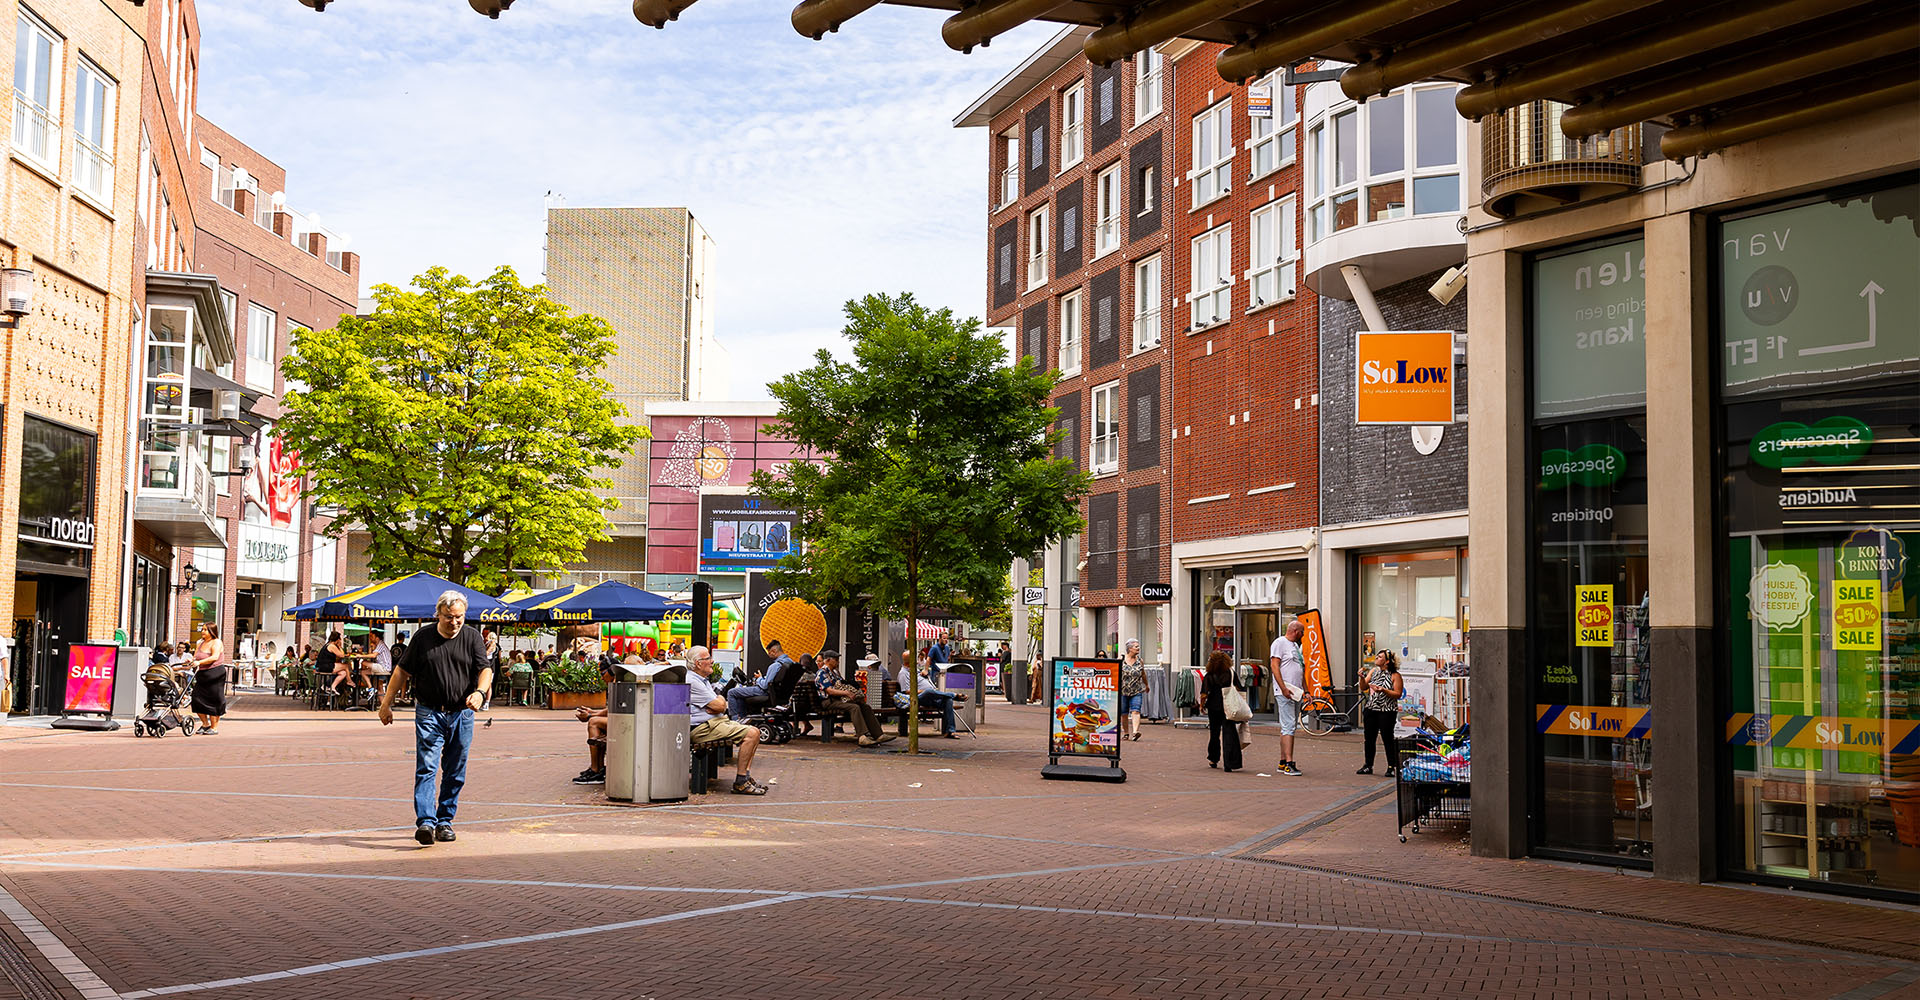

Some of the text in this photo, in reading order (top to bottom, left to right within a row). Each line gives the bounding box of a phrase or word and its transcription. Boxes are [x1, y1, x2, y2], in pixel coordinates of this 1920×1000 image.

[51, 516, 94, 543] norah
[1857, 545, 1885, 558] KOM
[1849, 559, 1896, 572] BINNEN
[1143, 587, 1171, 596] ONLY
[1224, 576, 1283, 606] ONLY
[1763, 581, 1798, 590] HUISJE,
[1581, 590, 1608, 602] SALE
[1763, 591, 1797, 600] HOBBY,
[1839, 586, 1874, 600] SALE
[353, 604, 399, 618] Duvel
[1761, 601, 1800, 610] FEESTJE!
[552, 608, 593, 620] Duvel
[1579, 608, 1610, 624] -50%
[1836, 606, 1876, 625] -50%
[1582, 629, 1608, 642] SALE
[1839, 631, 1875, 645] SALE
[71, 665, 112, 680] SALE
[1060, 676, 1115, 689] FESTIVAL
[1059, 687, 1112, 700] HOPPER!
[1569, 711, 1623, 731] SoLow
[1815, 722, 1886, 746] SoLow
